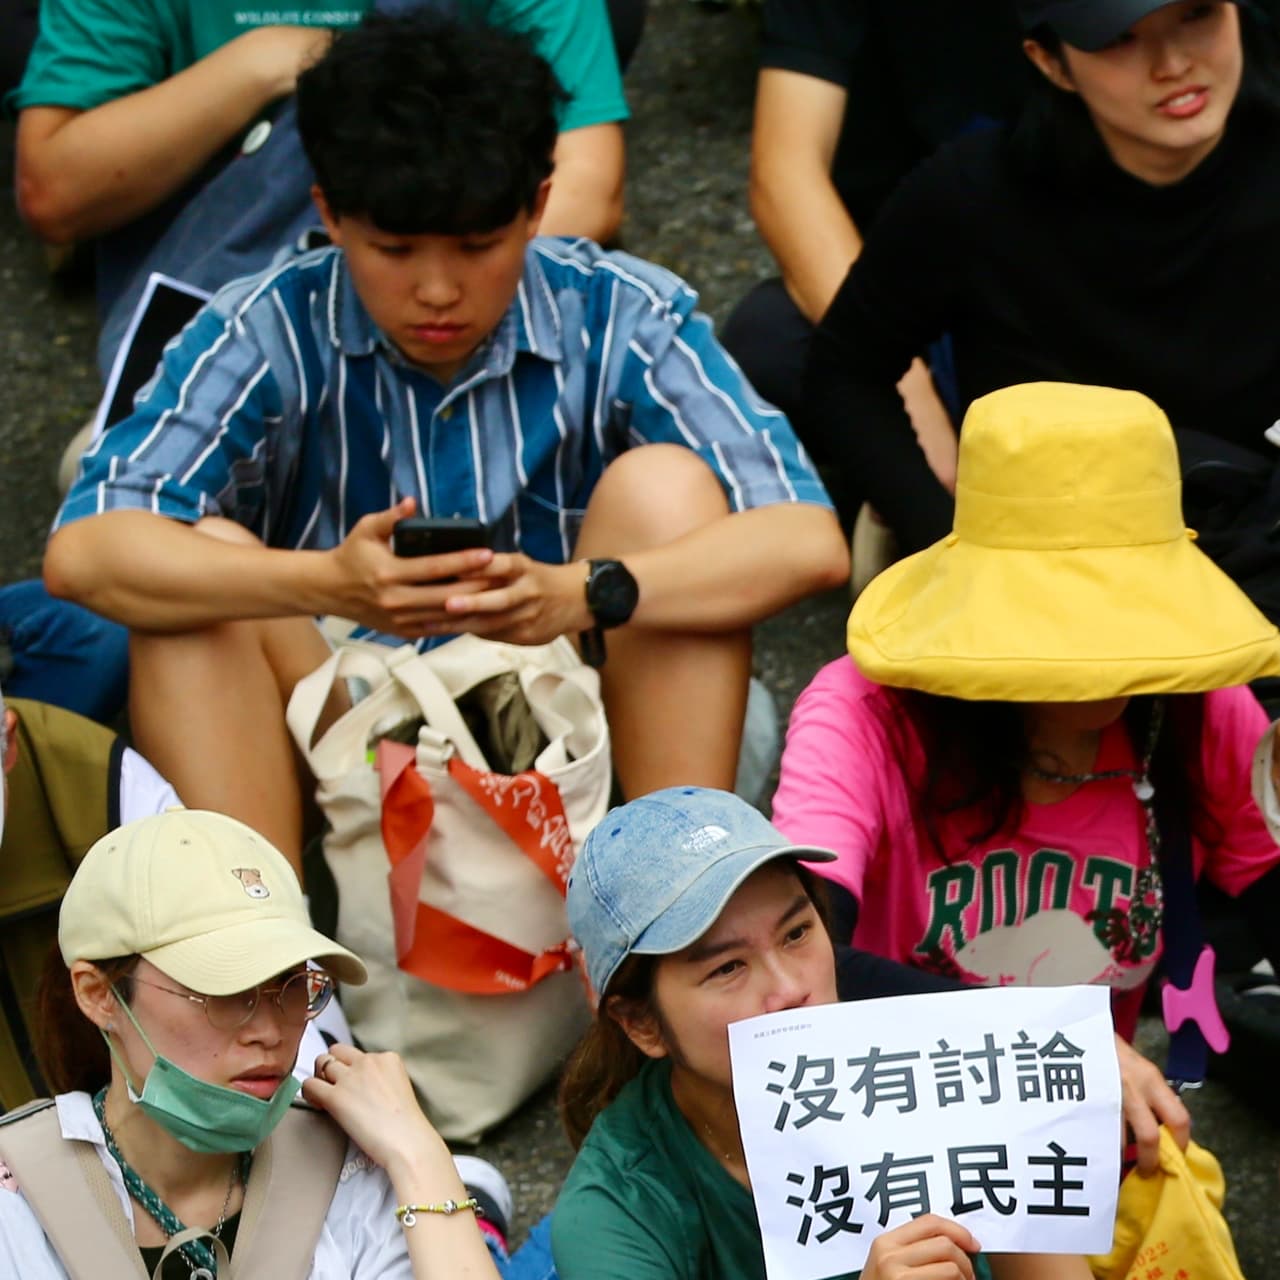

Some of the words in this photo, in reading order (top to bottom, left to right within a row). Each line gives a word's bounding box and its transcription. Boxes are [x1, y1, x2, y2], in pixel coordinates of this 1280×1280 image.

[765, 1030, 1086, 1133] 沒有討論
[785, 1141, 1091, 1246] 沒有民主
